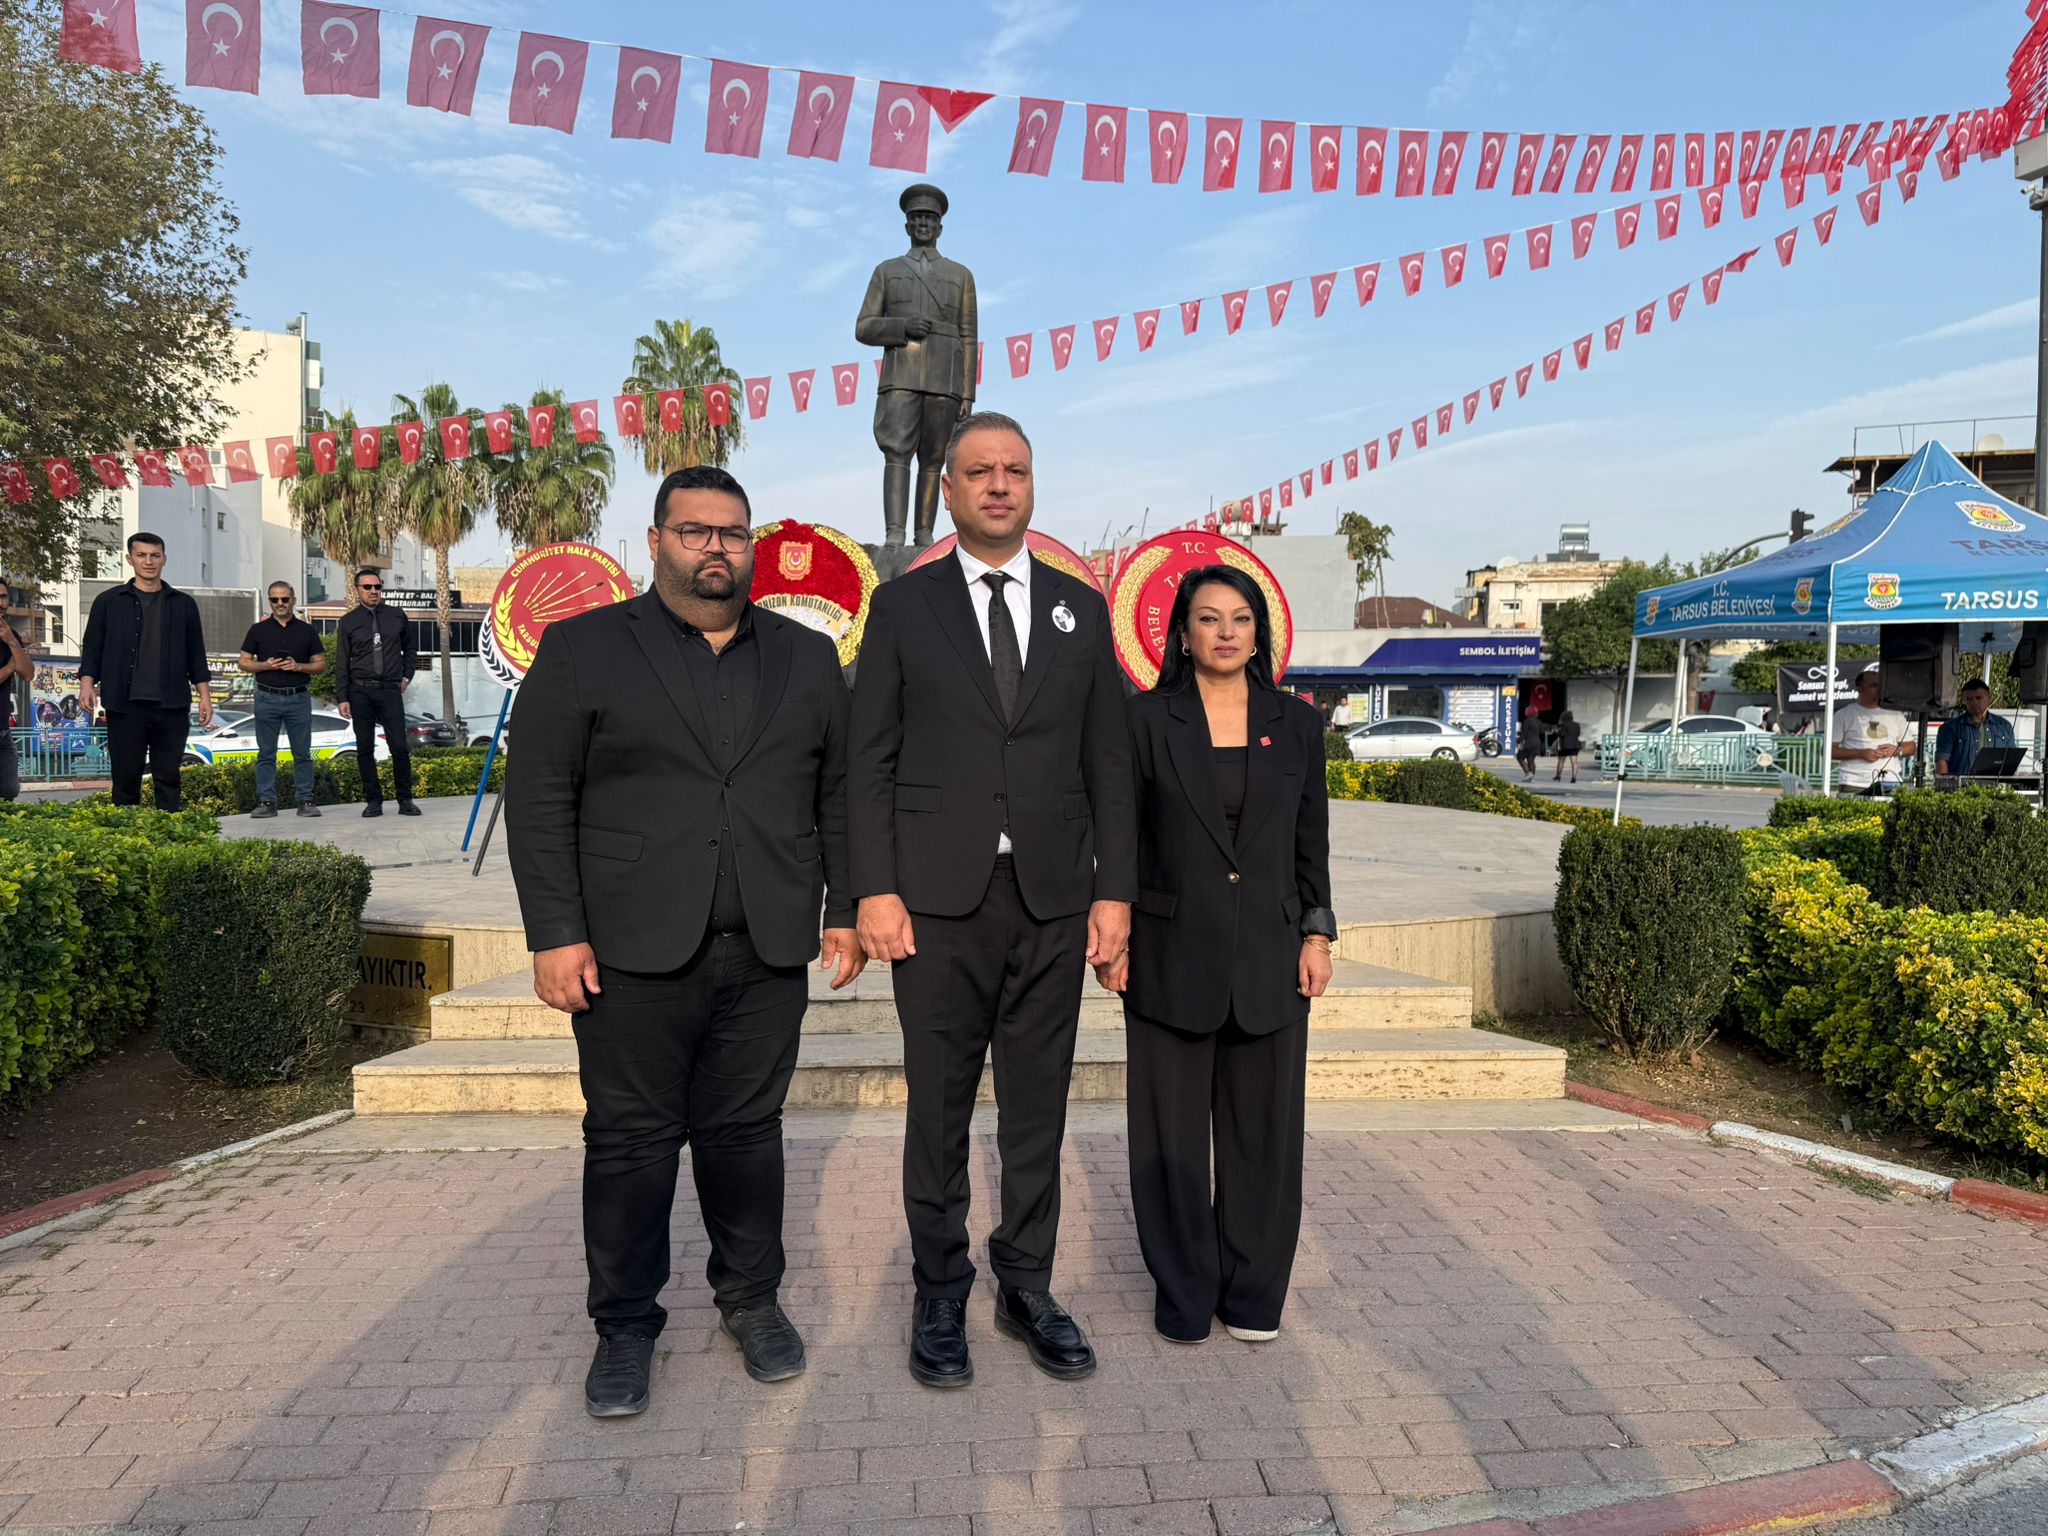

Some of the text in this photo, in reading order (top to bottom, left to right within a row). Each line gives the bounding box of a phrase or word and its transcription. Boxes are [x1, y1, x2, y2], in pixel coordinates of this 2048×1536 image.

[1181, 541, 1208, 554] T.C.
[1950, 539, 2048, 551] TARS
[511, 545, 622, 578] CUMHURİYET HALK PARTİSİ
[1163, 570, 1185, 588] TA
[1712, 579, 1730, 598] T.C.
[384, 599, 431, 608] RESTAURANT
[1941, 590, 2039, 610] TARSUS
[1668, 602, 1709, 622] TARSUS
[1710, 595, 1776, 617] BELEDİYESİ
[1459, 644, 1536, 657] SEMBOL İLETİŞİM
[224, 662, 242, 672] MA
[1797, 681, 1825, 691] Sonsuz
[1788, 691, 1817, 702] minnet
[1833, 689, 1860, 700] zlemle
[1504, 695, 1512, 751] AKSESUAR
[356, 955, 432, 991] AYIKTIR.
